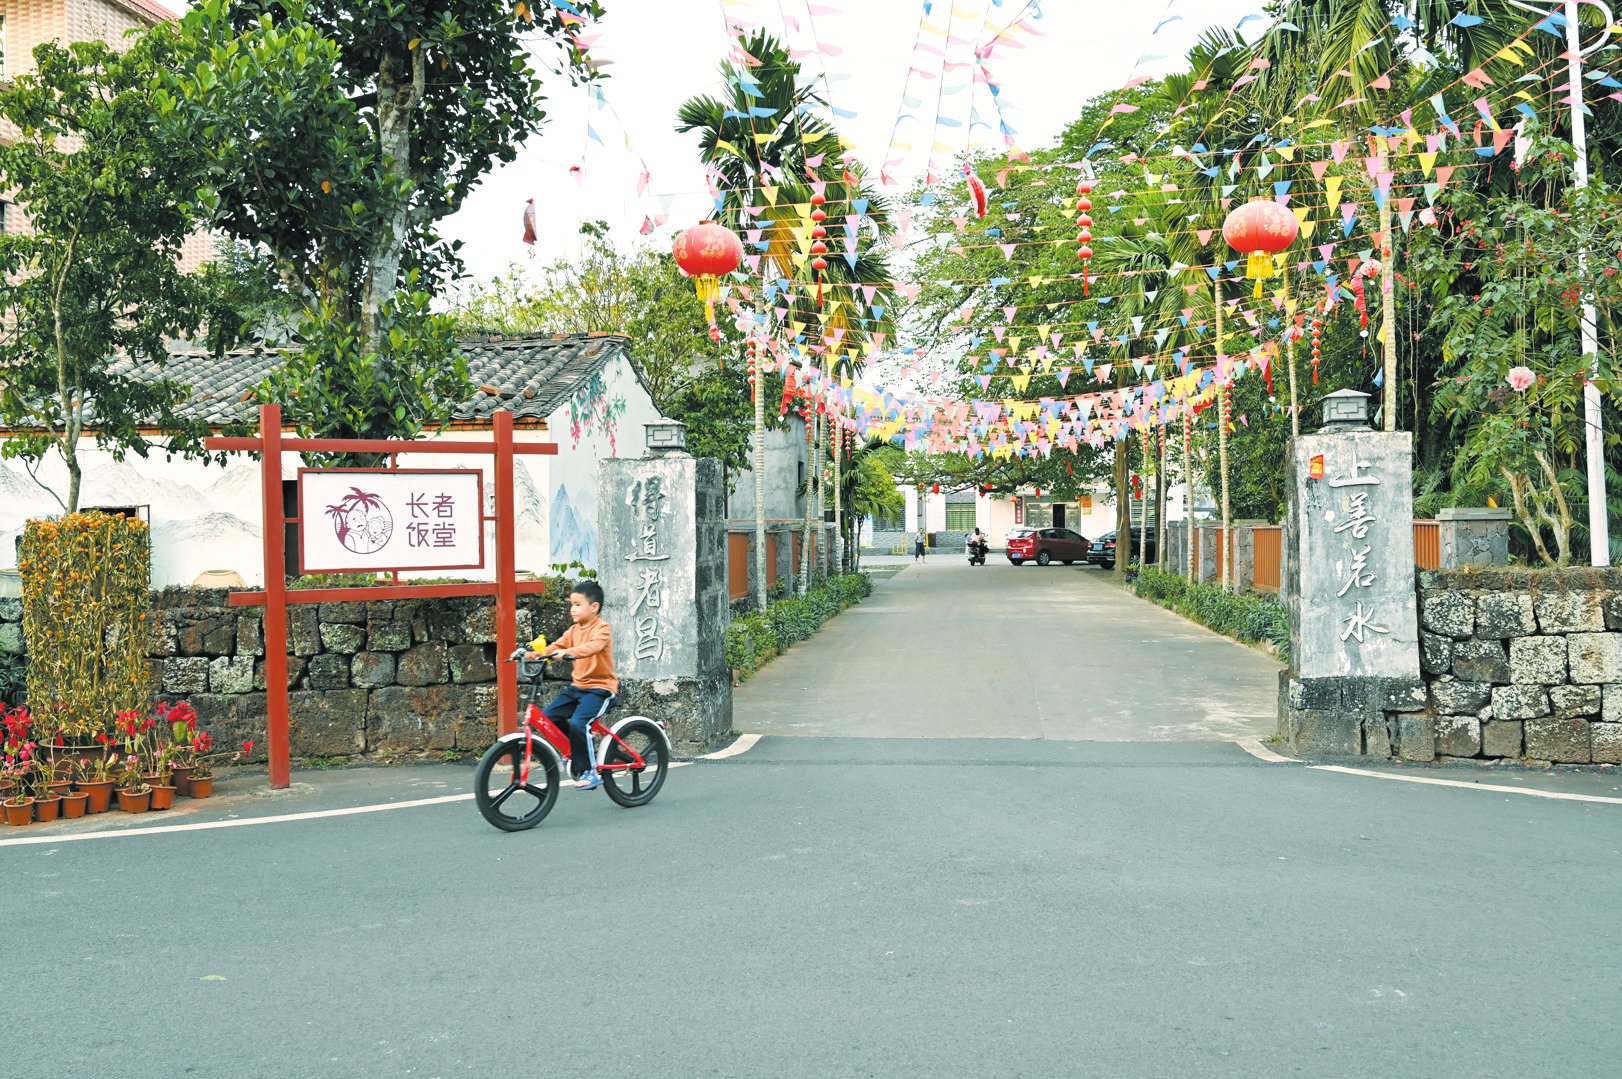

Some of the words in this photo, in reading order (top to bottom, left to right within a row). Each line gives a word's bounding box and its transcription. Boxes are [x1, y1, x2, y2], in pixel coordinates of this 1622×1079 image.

[405, 492, 455, 518] 长者
[405, 521, 456, 547] 饭堂
[1328, 450, 1389, 643] 上善若水
[625, 475, 670, 662] 得道者昌
